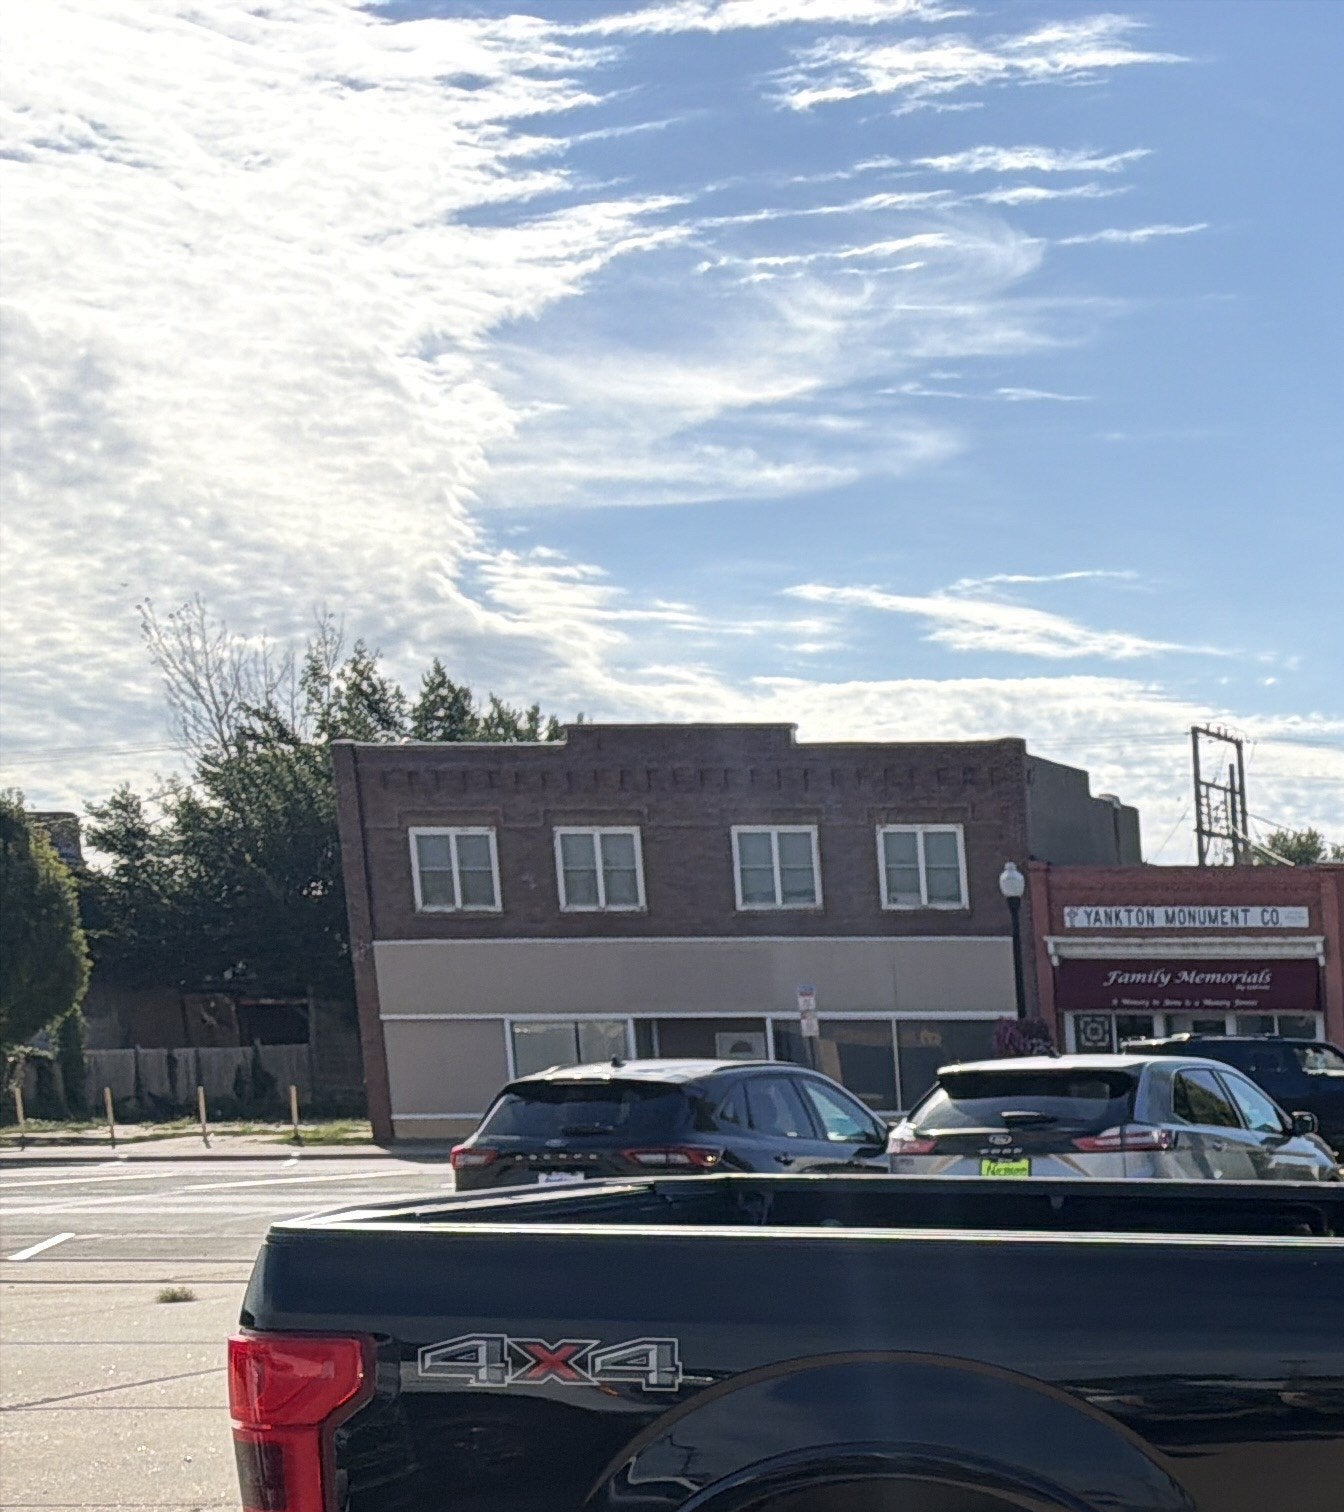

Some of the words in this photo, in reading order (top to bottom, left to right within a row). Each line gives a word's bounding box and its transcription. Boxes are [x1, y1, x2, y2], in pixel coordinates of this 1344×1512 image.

[1084, 908, 1154, 927] YANKTON
[1164, 908, 1250, 927] MONUMENT
[1102, 969, 1171, 988] Family
[1175, 968, 1272, 984] Memorials
